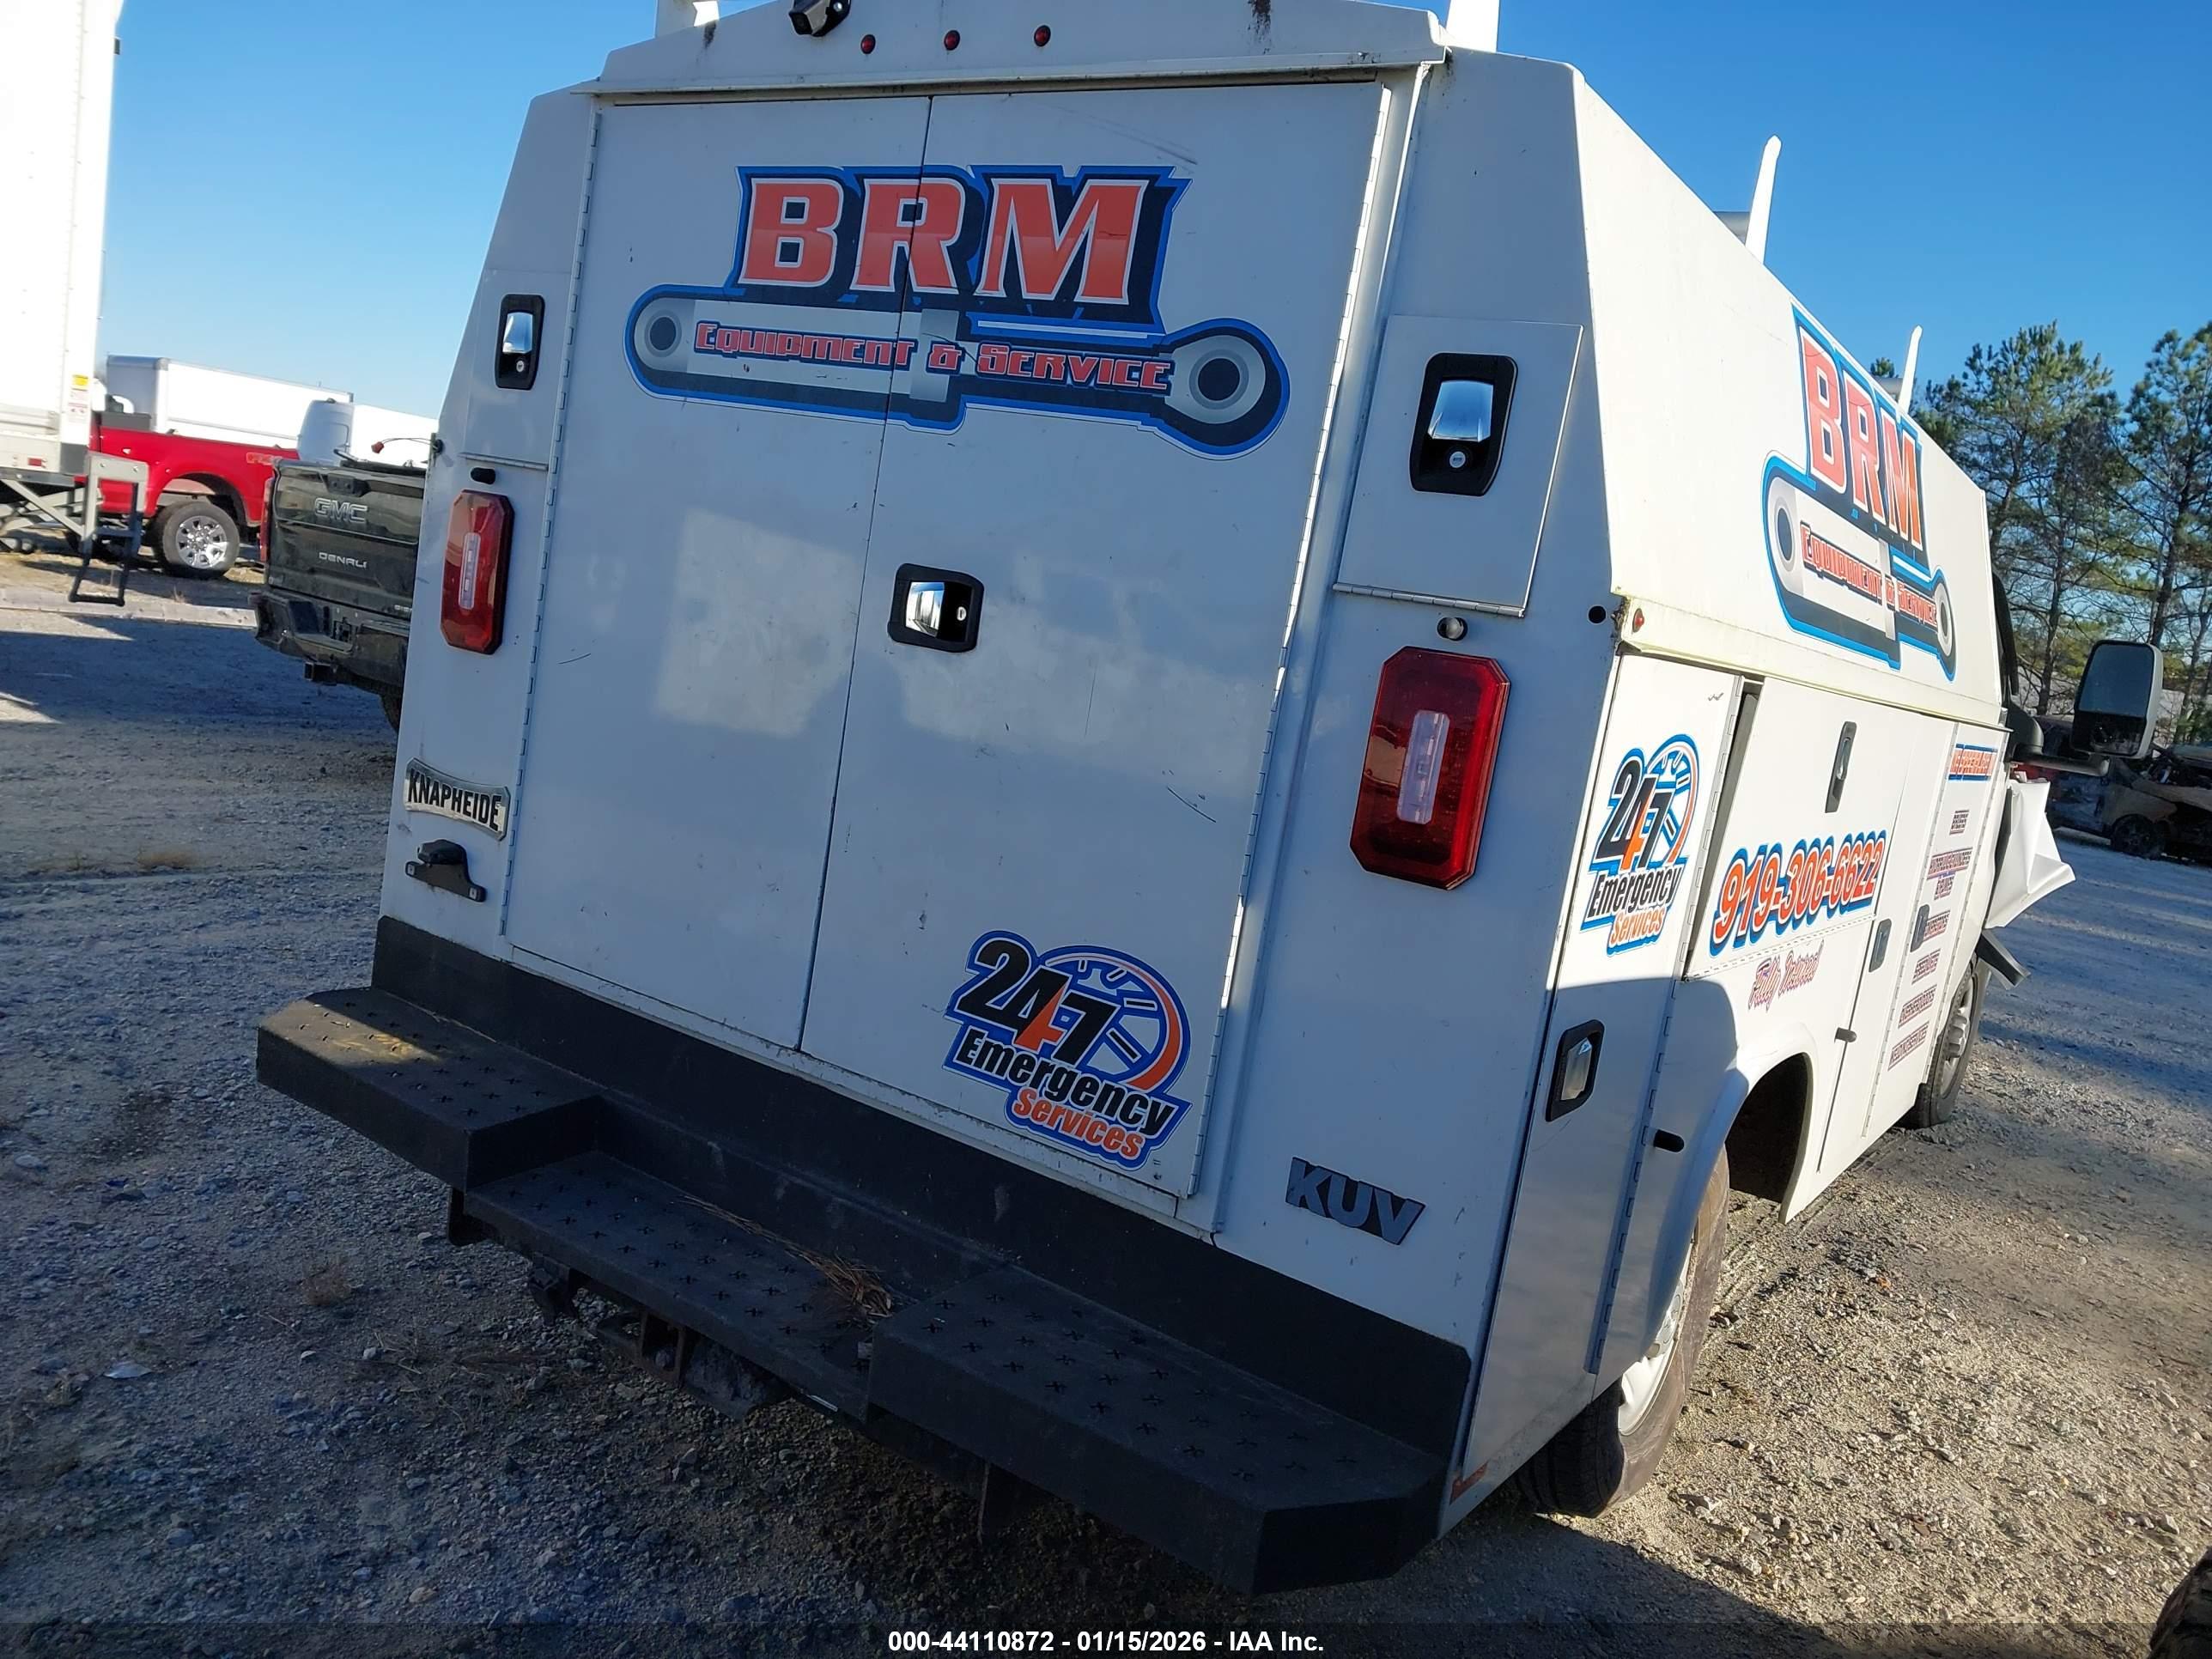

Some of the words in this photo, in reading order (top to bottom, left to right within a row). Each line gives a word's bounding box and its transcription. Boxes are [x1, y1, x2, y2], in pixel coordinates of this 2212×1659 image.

[737, 176, 1150, 305] BRM
[927, 343, 962, 372] &
[1799, 325, 1923, 552] BRM
[314, 497, 368, 524] GMC
[319, 551, 367, 568] DENALI
[408, 769, 502, 832] KNAPHEIDE
[1587, 864, 1683, 916] Emergency
[1711, 833, 1886, 951] 919-306-6622
[1610, 905, 1667, 948] Services
[952, 1025, 1179, 1138] Emergency
[1012, 1086, 1146, 1160] Services
[1286, 1158, 1425, 1244] KUV
